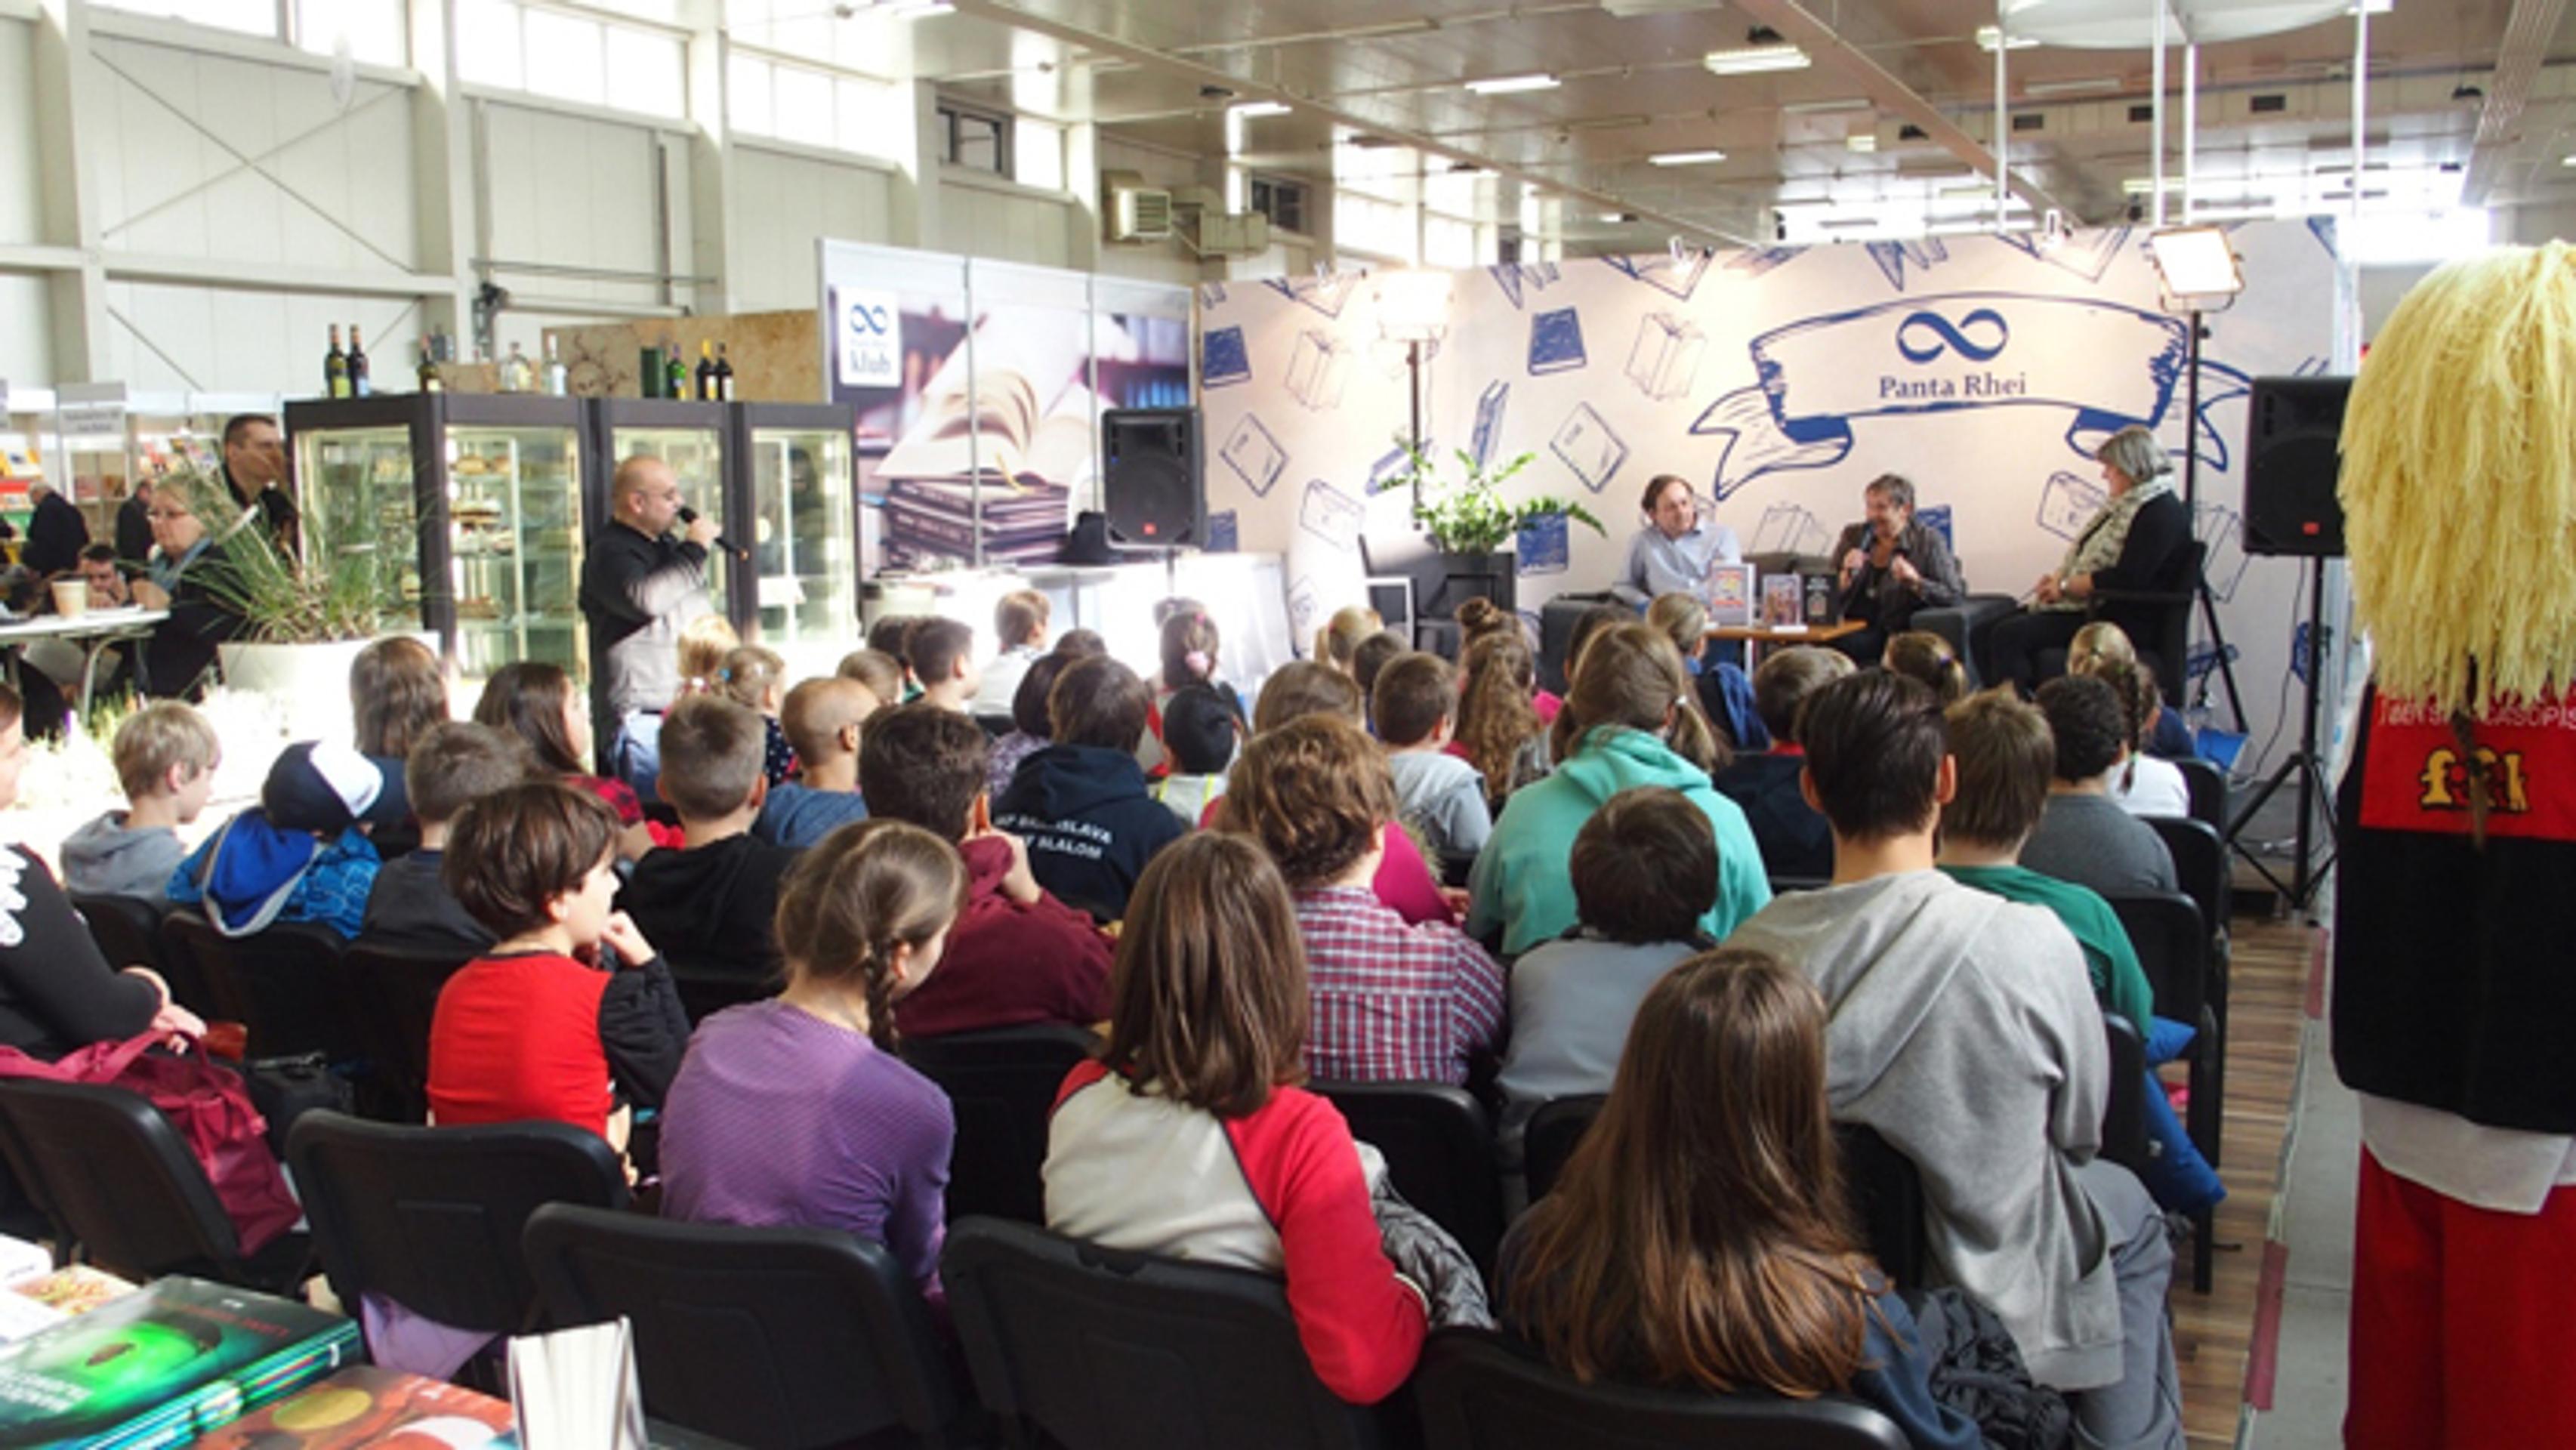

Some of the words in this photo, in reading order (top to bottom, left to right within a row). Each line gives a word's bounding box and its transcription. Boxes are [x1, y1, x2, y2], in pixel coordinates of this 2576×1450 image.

[1879, 377, 1955, 397] Panta
[1964, 372, 2025, 396] Rhei
[1038, 835, 1103, 859] SLALOM
